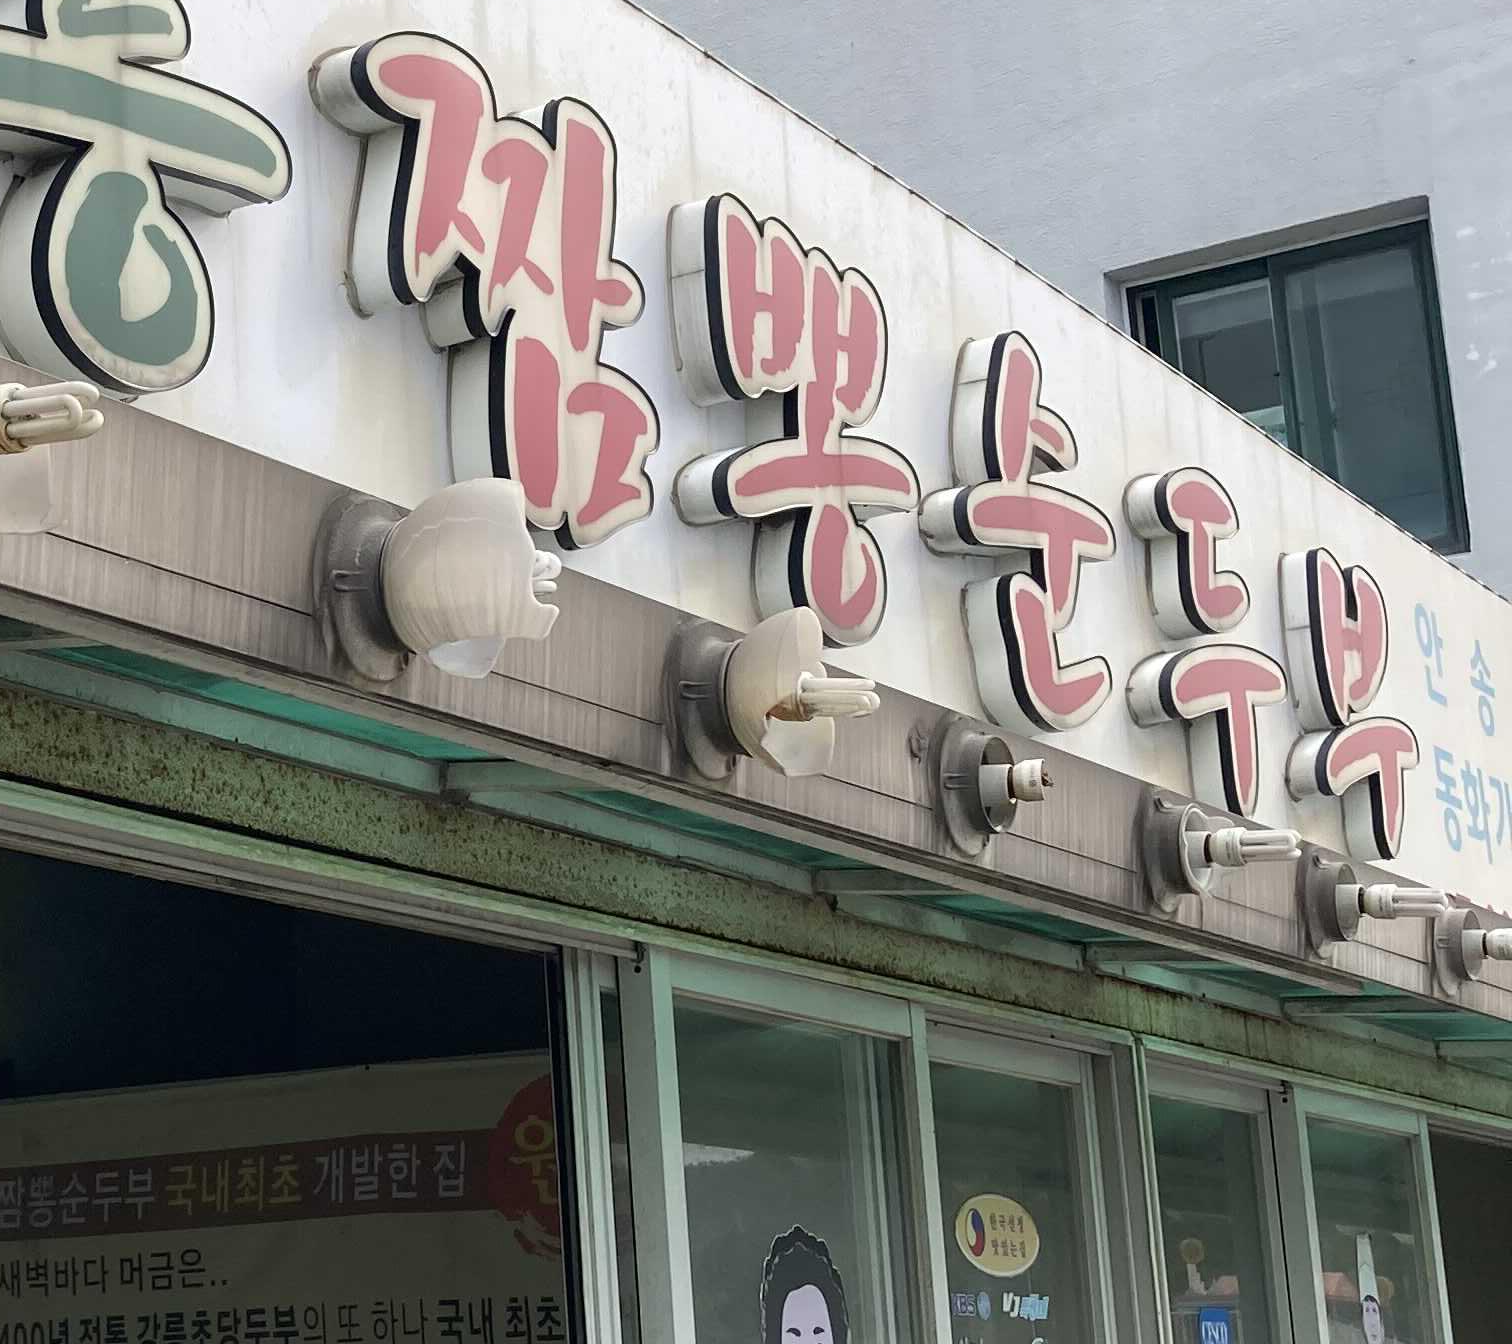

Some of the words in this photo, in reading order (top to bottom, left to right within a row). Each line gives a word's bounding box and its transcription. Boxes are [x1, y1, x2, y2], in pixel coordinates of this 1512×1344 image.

[165, 1155, 303, 1215] 국내최초
[313, 1143, 422, 1204] 개발한
[432, 1139, 467, 1199] 집
[119, 1248, 229, 1292] 머금은..
[337, 1302, 365, 1344] 또
[504, 1295, 565, 1343] 최초
